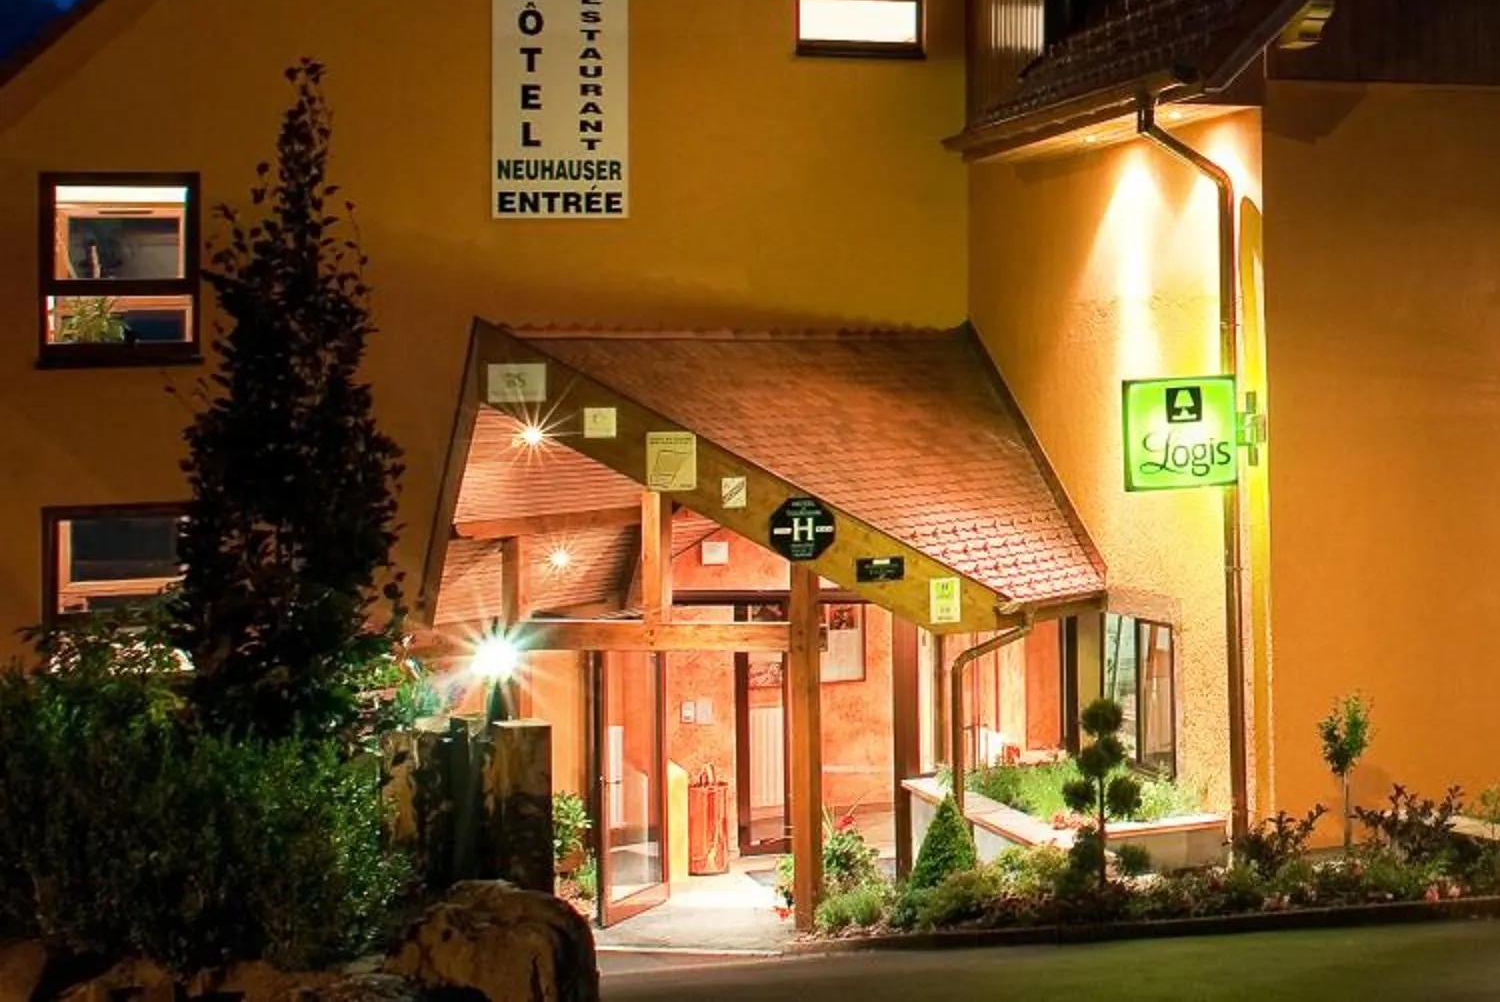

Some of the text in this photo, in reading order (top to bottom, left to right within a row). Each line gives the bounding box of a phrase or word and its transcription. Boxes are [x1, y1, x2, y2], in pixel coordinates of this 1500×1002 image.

[496, 159, 622, 181] NEUHAUSER
[497, 185, 623, 213] ENTRÉE
[1139, 431, 1231, 476] Logis
[793, 517, 814, 541] H
